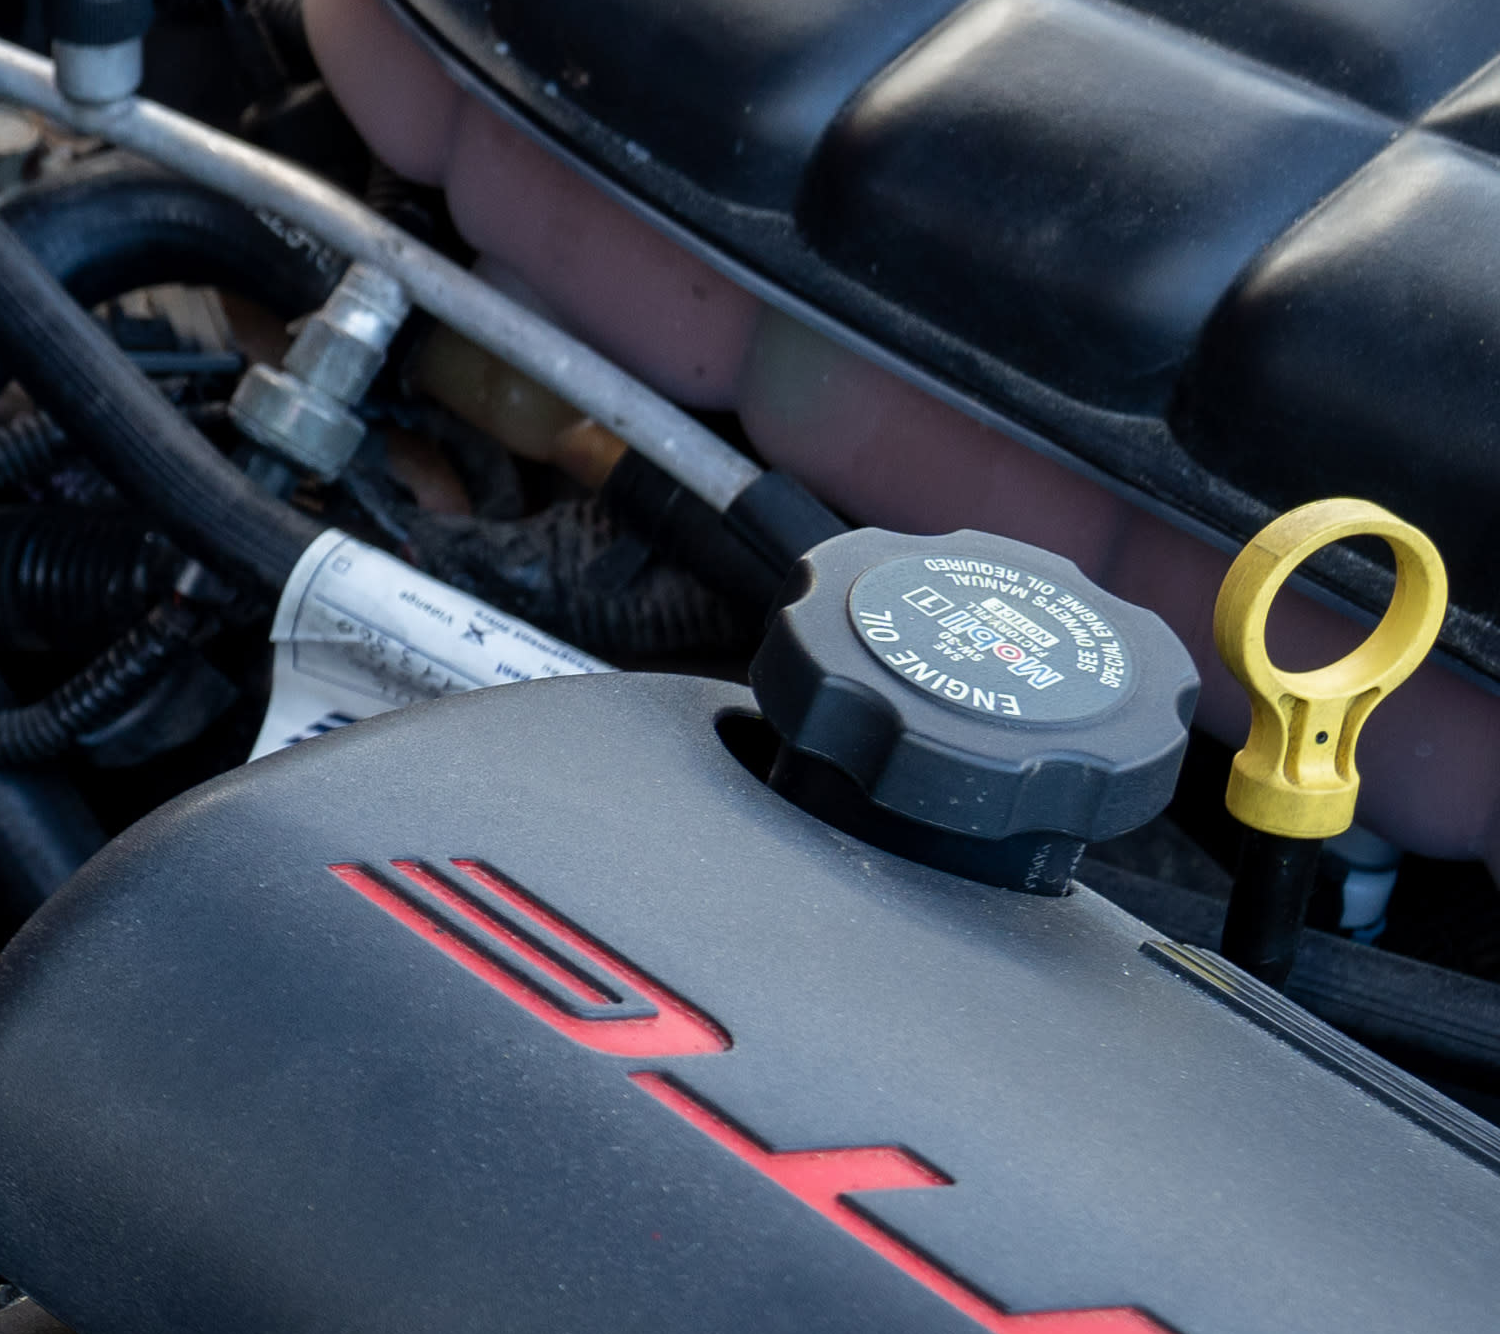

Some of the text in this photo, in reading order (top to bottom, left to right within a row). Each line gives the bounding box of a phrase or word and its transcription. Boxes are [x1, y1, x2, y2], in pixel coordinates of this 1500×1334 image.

[924, 559, 1125, 688] SPECIAL ENGINE OIL REQUIRED
[933, 641, 965, 662] SAE
[937, 610, 1065, 690] Mobil
[938, 631, 985, 662] 5W-30
[945, 573, 1098, 673] SEE OWNER'S MANUAL
[965, 601, 1049, 658] FACTORY FILL
[986, 601, 1050, 645] NOTICE
[859, 610, 1022, 716] ENGINE OIL
